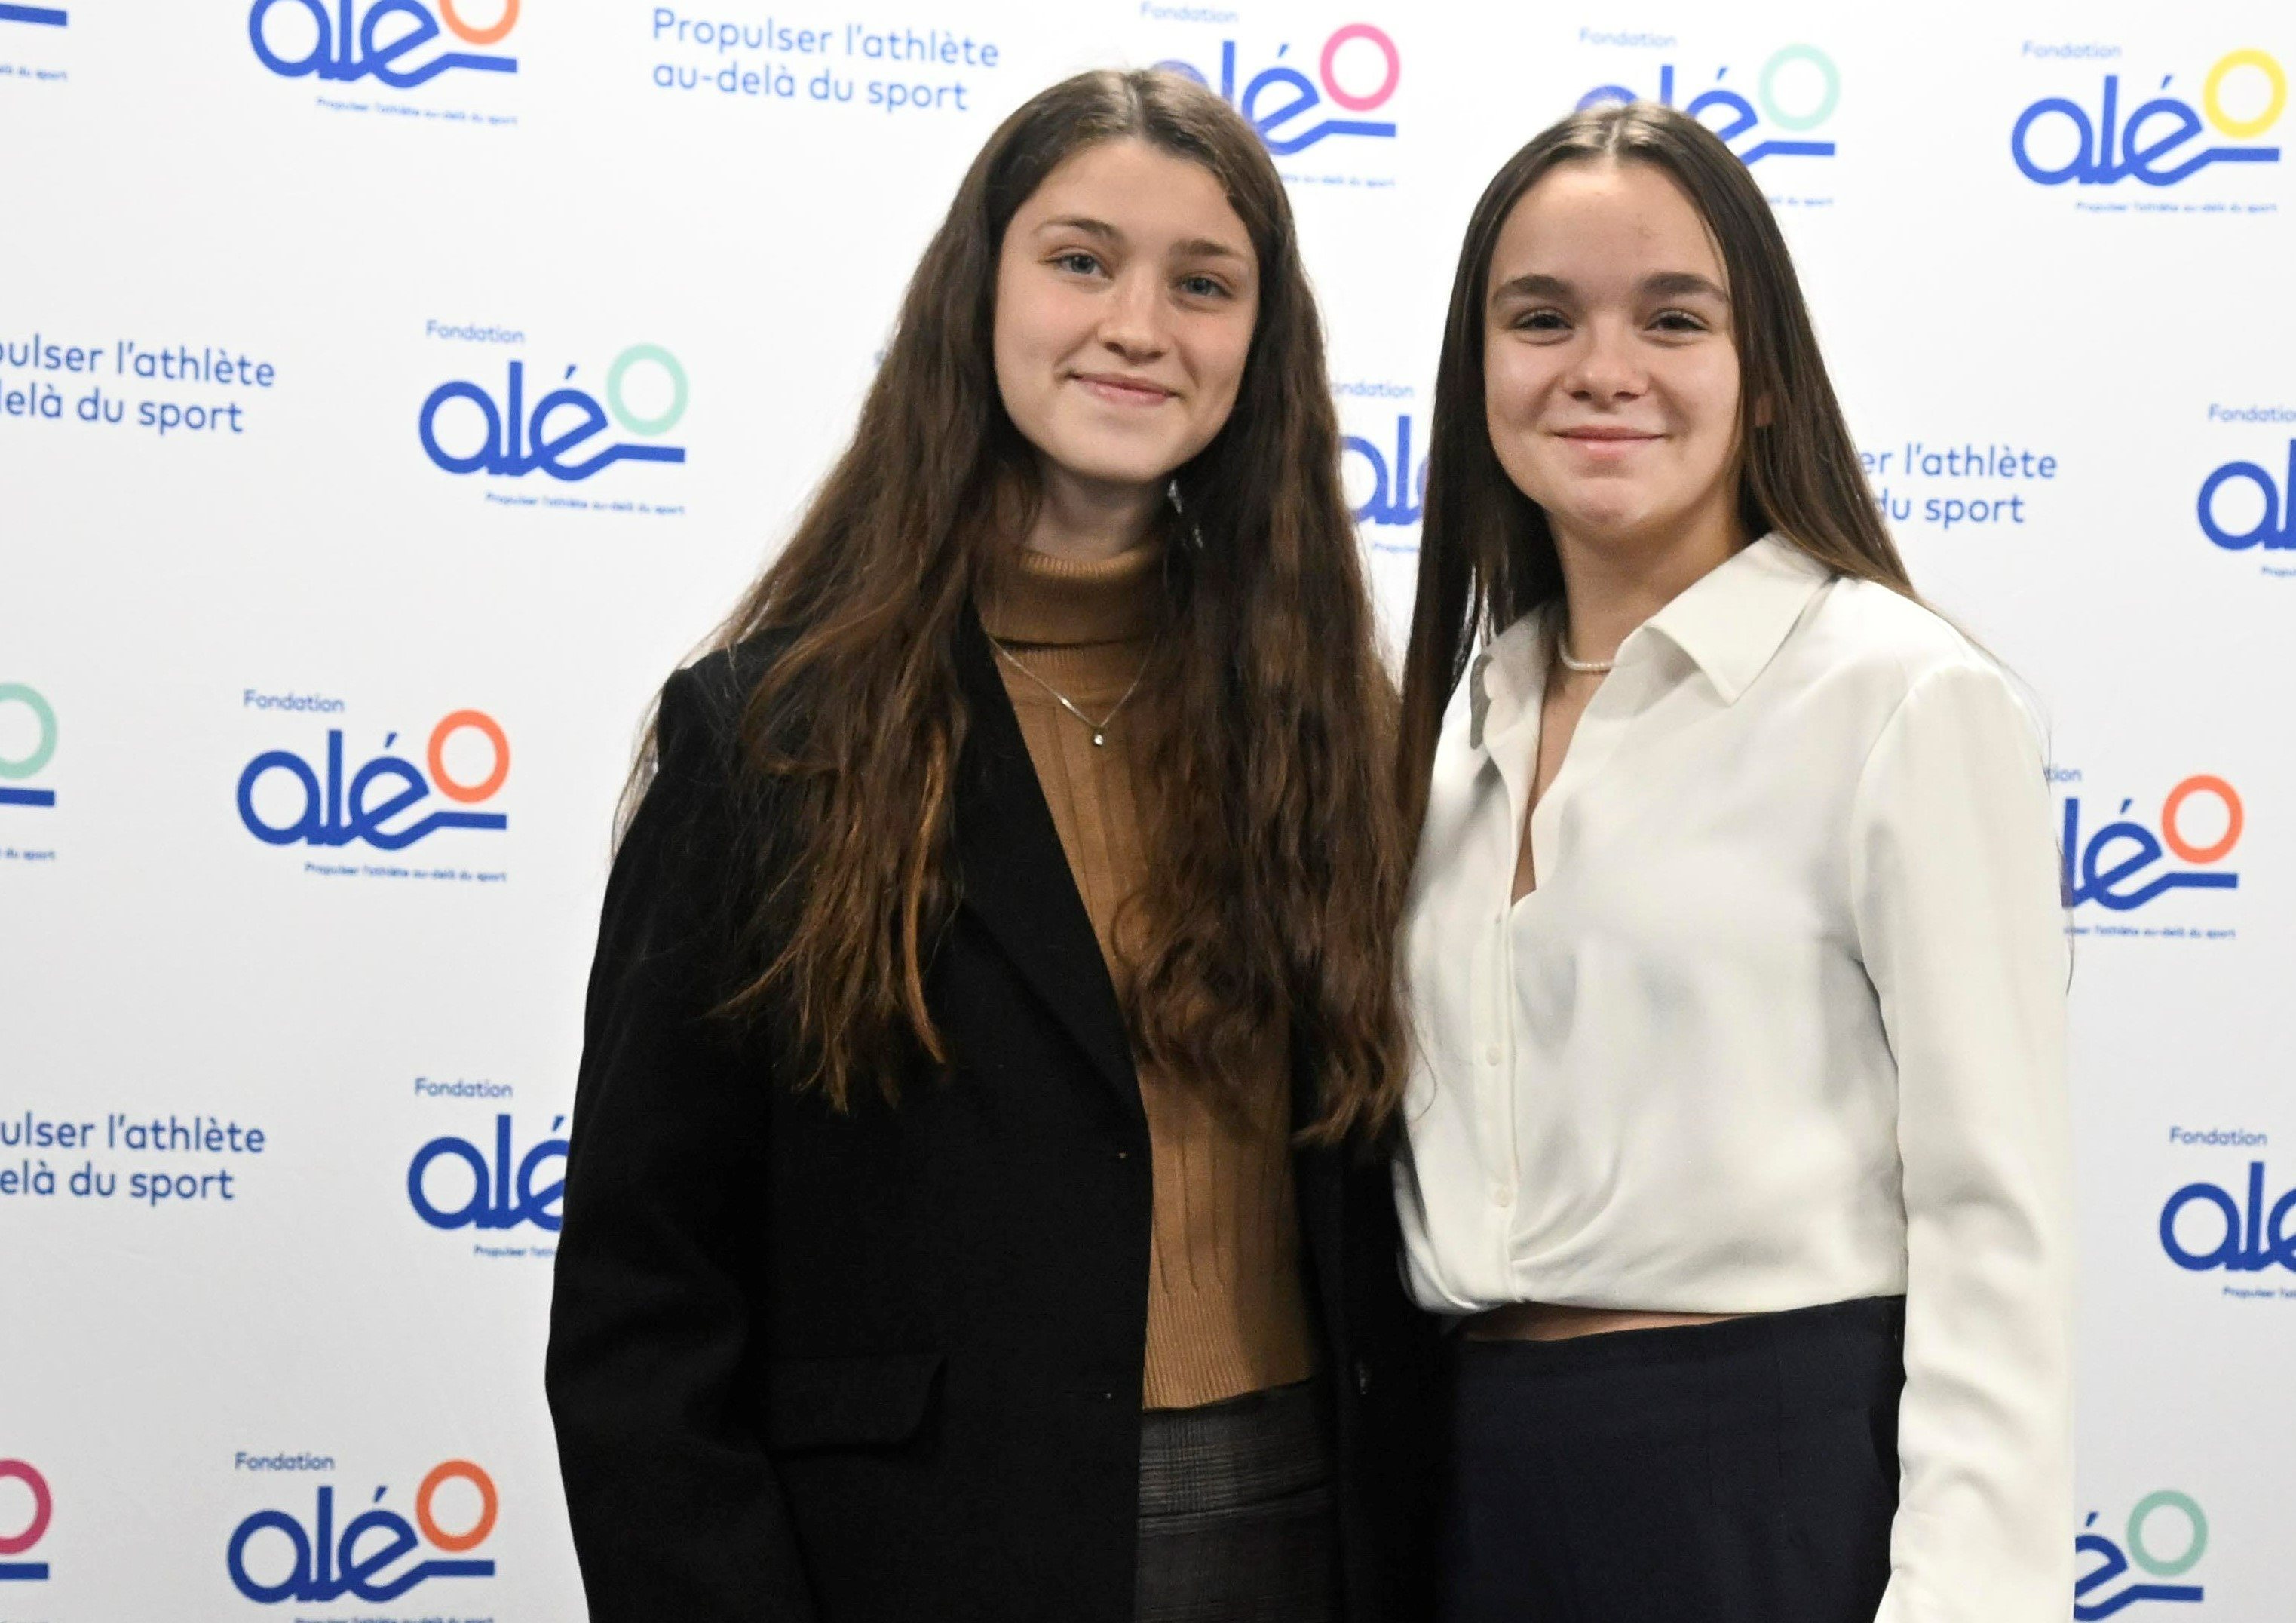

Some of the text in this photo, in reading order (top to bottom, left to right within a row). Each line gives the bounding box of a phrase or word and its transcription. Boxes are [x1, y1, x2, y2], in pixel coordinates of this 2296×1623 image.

[1139, 0, 1240, 23] Fondation
[652, 8, 1000, 68] Propulser l'athlète
[1578, 26, 1678, 48] Fondation
[2022, 40, 2122, 60] Fondation
[652, 61, 969, 113] au-delà du sport
[425, 319, 526, 344] Fondation
[0, 333, 275, 388] ulser l'athlète
[0, 379, 244, 436] elà du sport
[418, 343, 688, 482] aléo
[1905, 443, 2058, 479] l'athlète
[1924, 495, 2025, 530] sport
[243, 689, 345, 713] Fondation
[236, 709, 510, 851] aléo
[2061, 773, 2244, 911] léo
[414, 1077, 514, 1099] Fondation
[0, 1111, 266, 1153] ulser l'athlète
[2169, 1125, 2268, 1146] Fondation
[0, 1158, 235, 1207] elà du sport
[234, 1451, 336, 1471] Fondation
[228, 1459, 498, 1604] aléo
